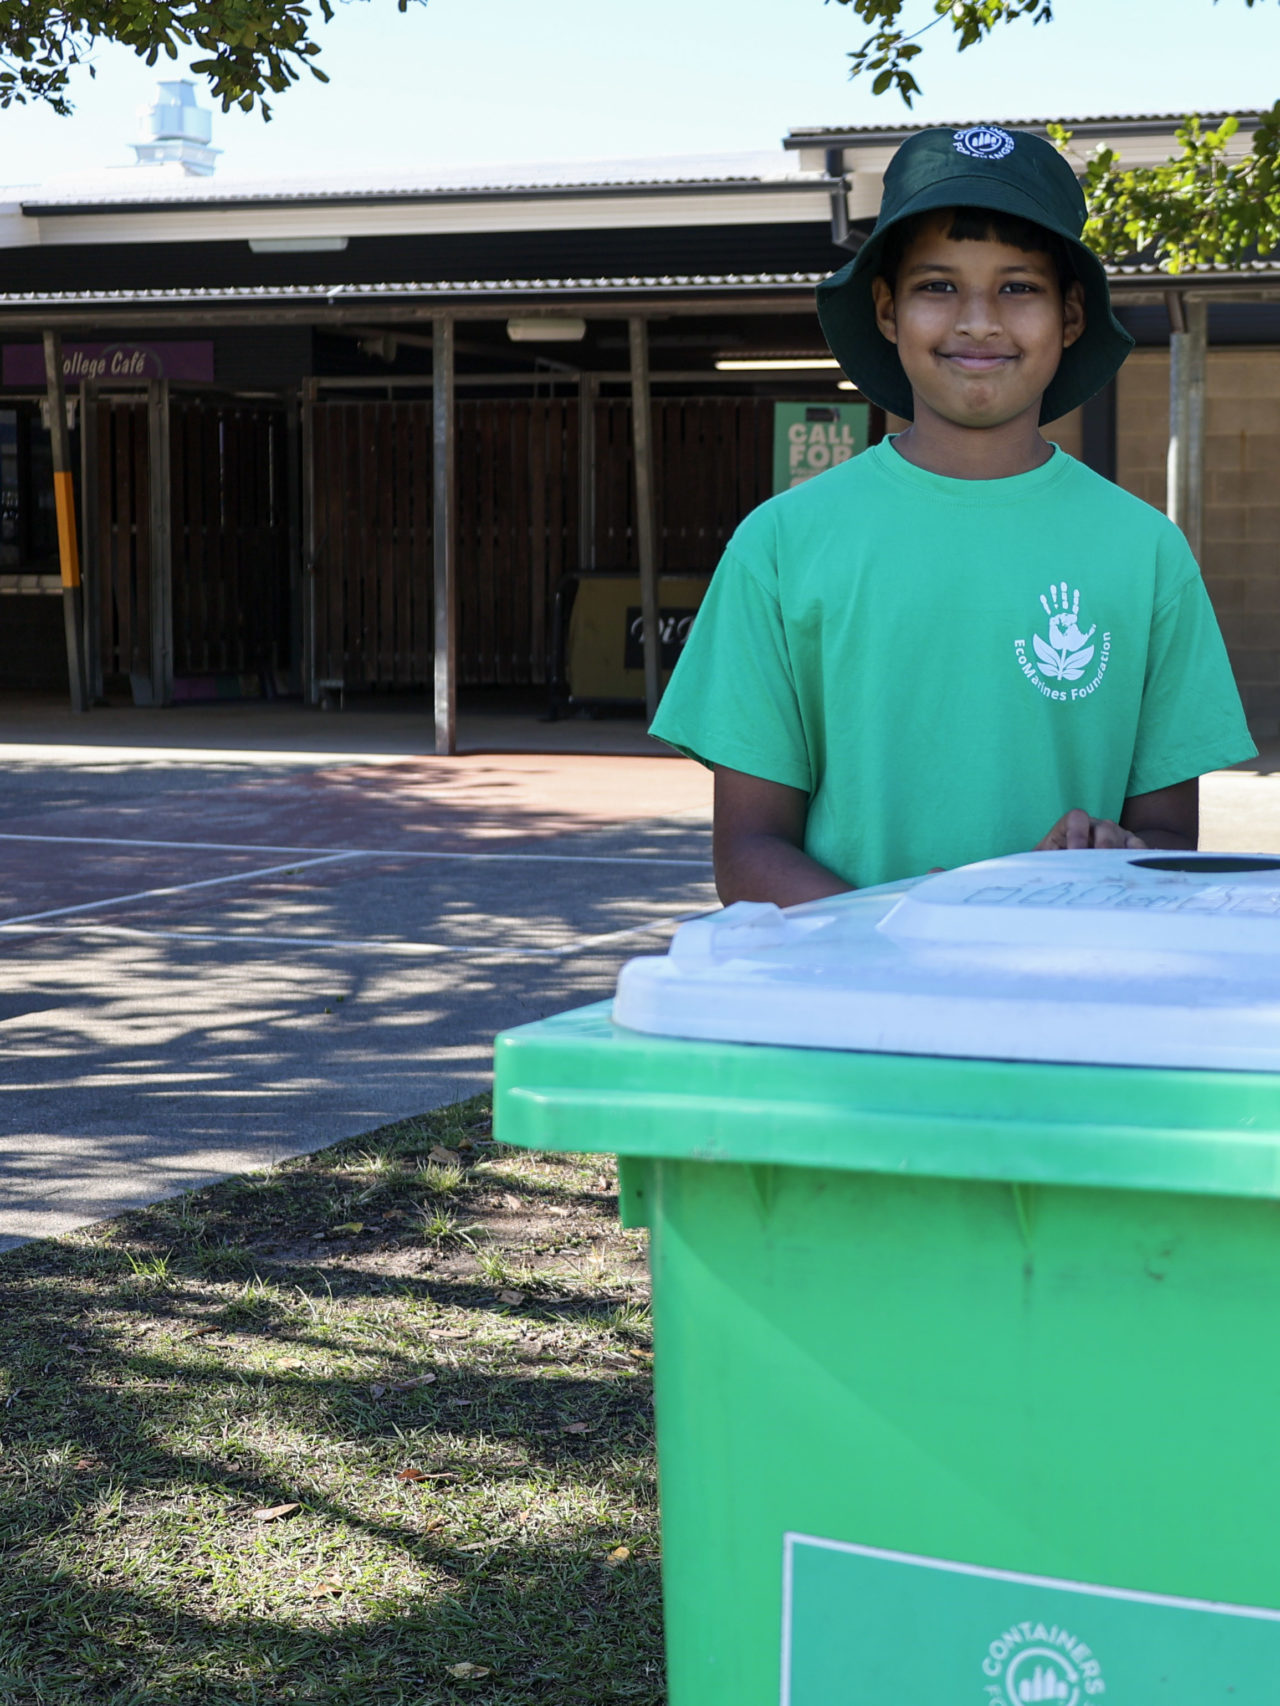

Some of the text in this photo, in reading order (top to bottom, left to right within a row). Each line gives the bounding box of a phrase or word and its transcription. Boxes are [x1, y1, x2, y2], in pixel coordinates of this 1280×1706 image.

[62, 350, 148, 379] ollege Café
[788, 423, 855, 445] CALL
[1014, 631, 1112, 701] EcoMarines Foundation
[982, 1620, 1107, 1695] CONTAINERS
